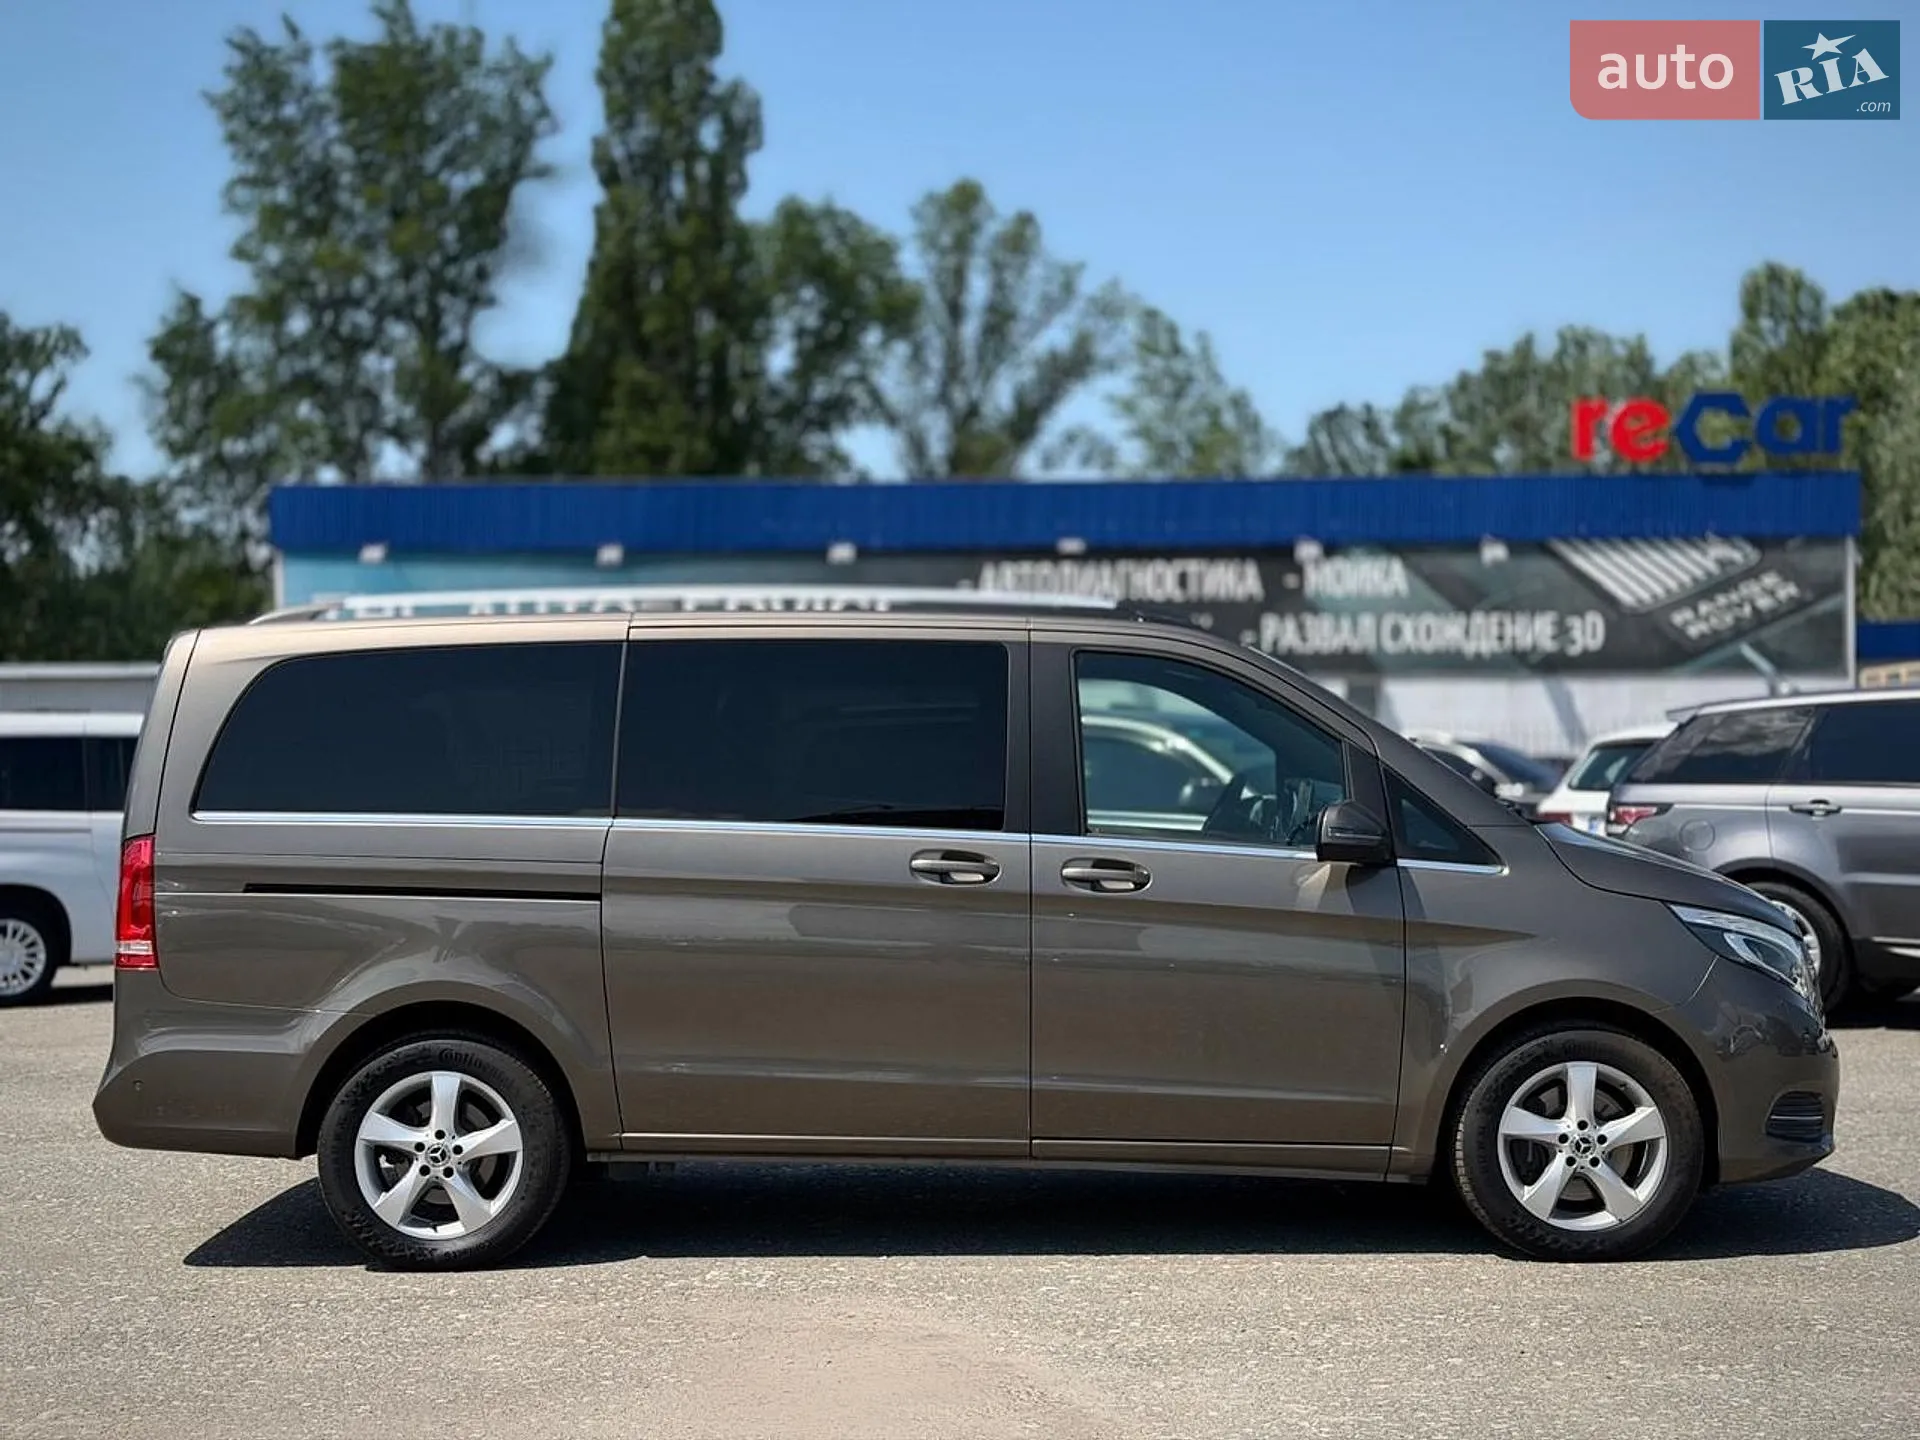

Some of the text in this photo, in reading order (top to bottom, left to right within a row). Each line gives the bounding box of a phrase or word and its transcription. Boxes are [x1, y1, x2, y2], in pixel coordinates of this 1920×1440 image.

[1570, 390, 1857, 463] reCar
[1260, 611, 1376, 654] РАЗВАЛ
[1379, 610, 1558, 660] СХОЖДЕНИЕ
[1564, 610, 1605, 657] 3D
